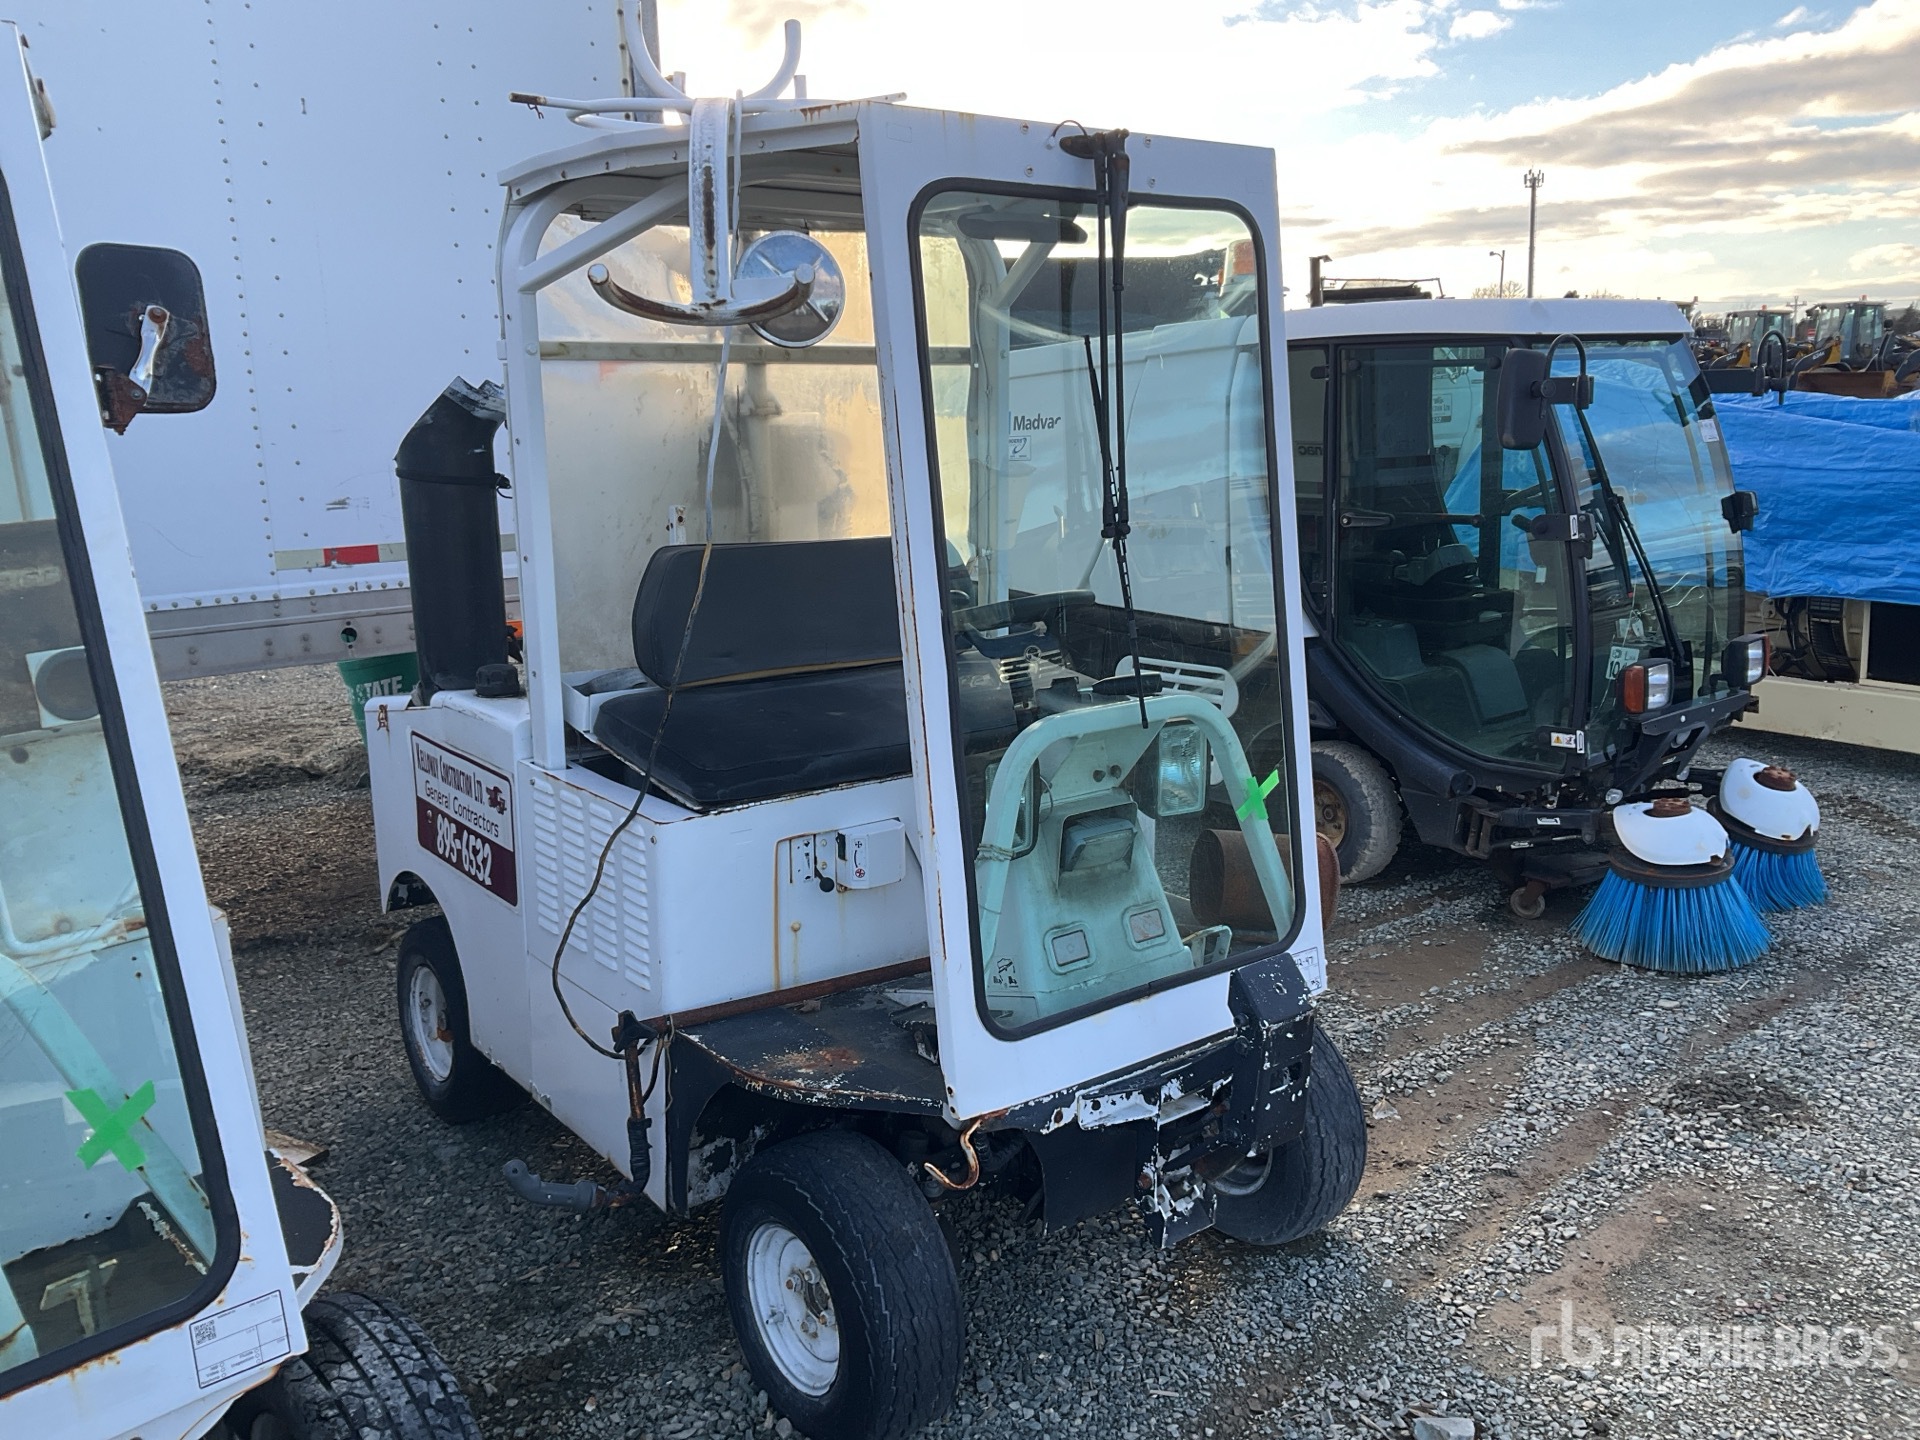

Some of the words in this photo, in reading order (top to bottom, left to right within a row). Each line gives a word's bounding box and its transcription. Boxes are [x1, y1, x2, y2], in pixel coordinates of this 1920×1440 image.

[425, 780, 450, 809] General
[453, 796, 499, 837] Contractors
[436, 813, 492, 886] 895-6532
